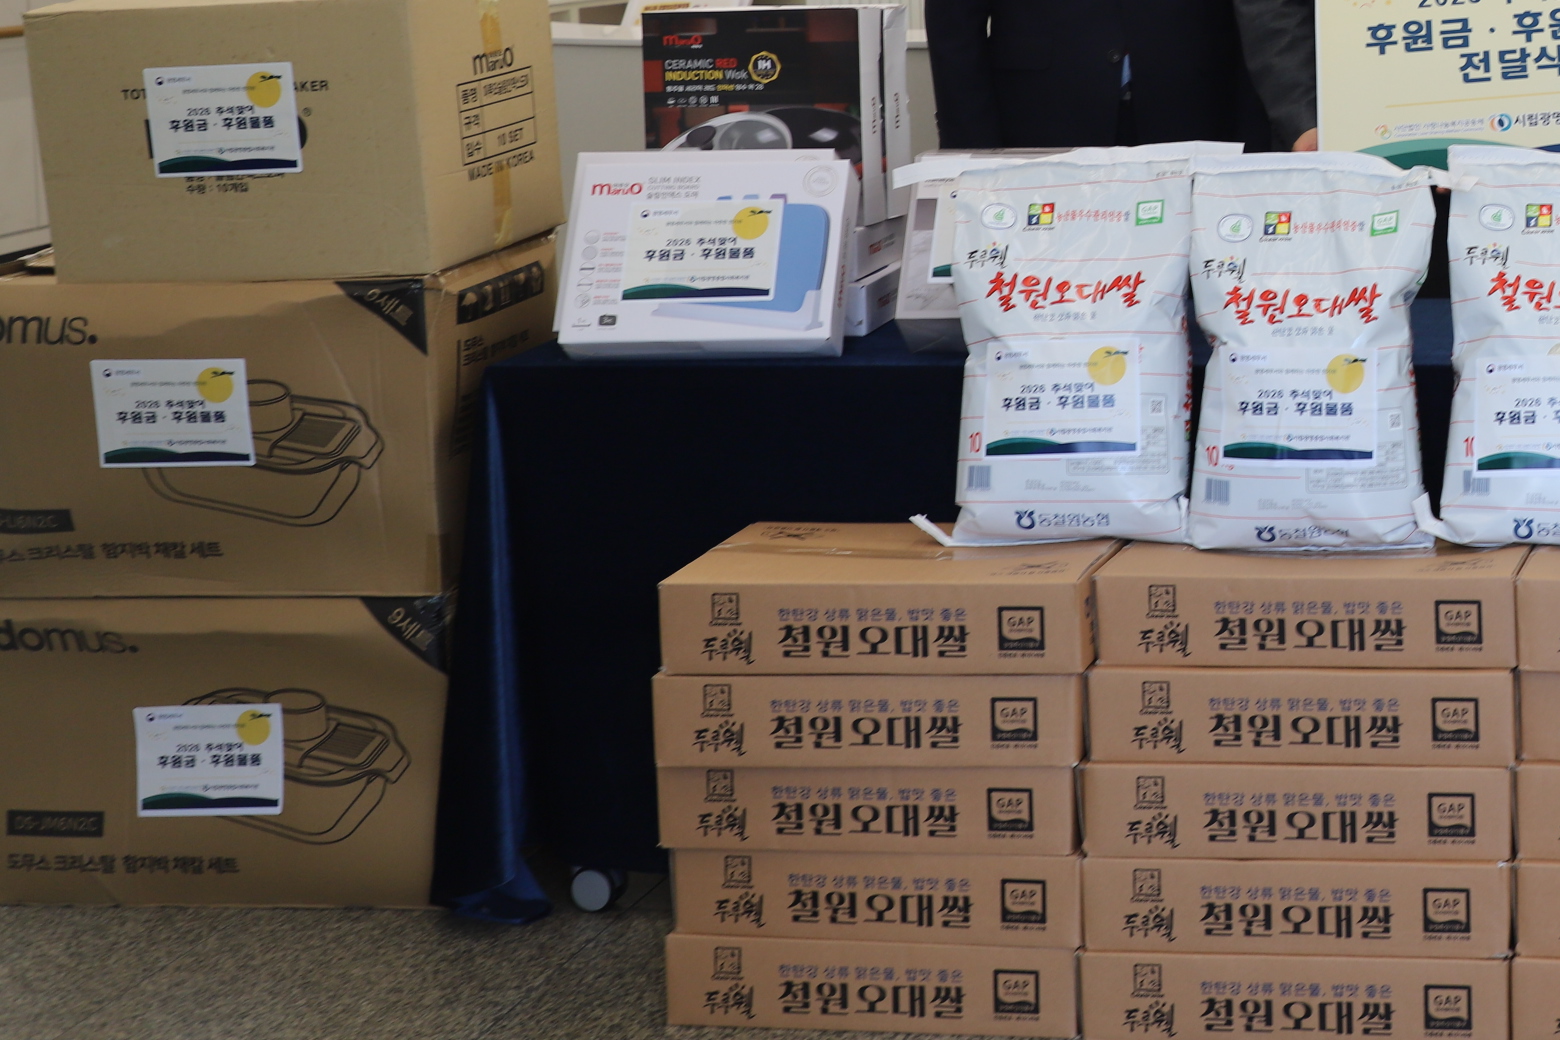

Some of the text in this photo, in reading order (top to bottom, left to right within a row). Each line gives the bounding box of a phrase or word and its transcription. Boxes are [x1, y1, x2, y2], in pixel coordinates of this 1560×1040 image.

[1366, 17, 1472, 55] 후원금
[664, 57, 738, 70] CERAMIC RED
[665, 69, 724, 81] INDUCTION
[985, 271, 1146, 313] 철원오대쌀
[1223, 282, 1383, 326] 철원오대쌀
[778, 607, 819, 622] 한탄강
[824, 608, 850, 622] 상류
[908, 608, 935, 622] 밥맛
[940, 608, 967, 622] 좋은
[1007, 616, 1035, 628] GAP
[1444, 610, 1472, 622] GAP
[778, 624, 969, 658] 철원오대쌀
[1214, 617, 1407, 652] 철원오대쌀
[770, 715, 962, 749] 철원오대쌀
[1209, 714, 1403, 749] 철원오대쌀
[771, 801, 960, 838] 철원오대쌀
[1204, 808, 1398, 845] 철원오대쌀
[787, 889, 974, 929] 철원오대쌀
[1200, 902, 1394, 940] 철원오대쌀
[778, 980, 966, 1020] 철원오대쌀
[1200, 998, 1395, 1036] 철원오대쌀
